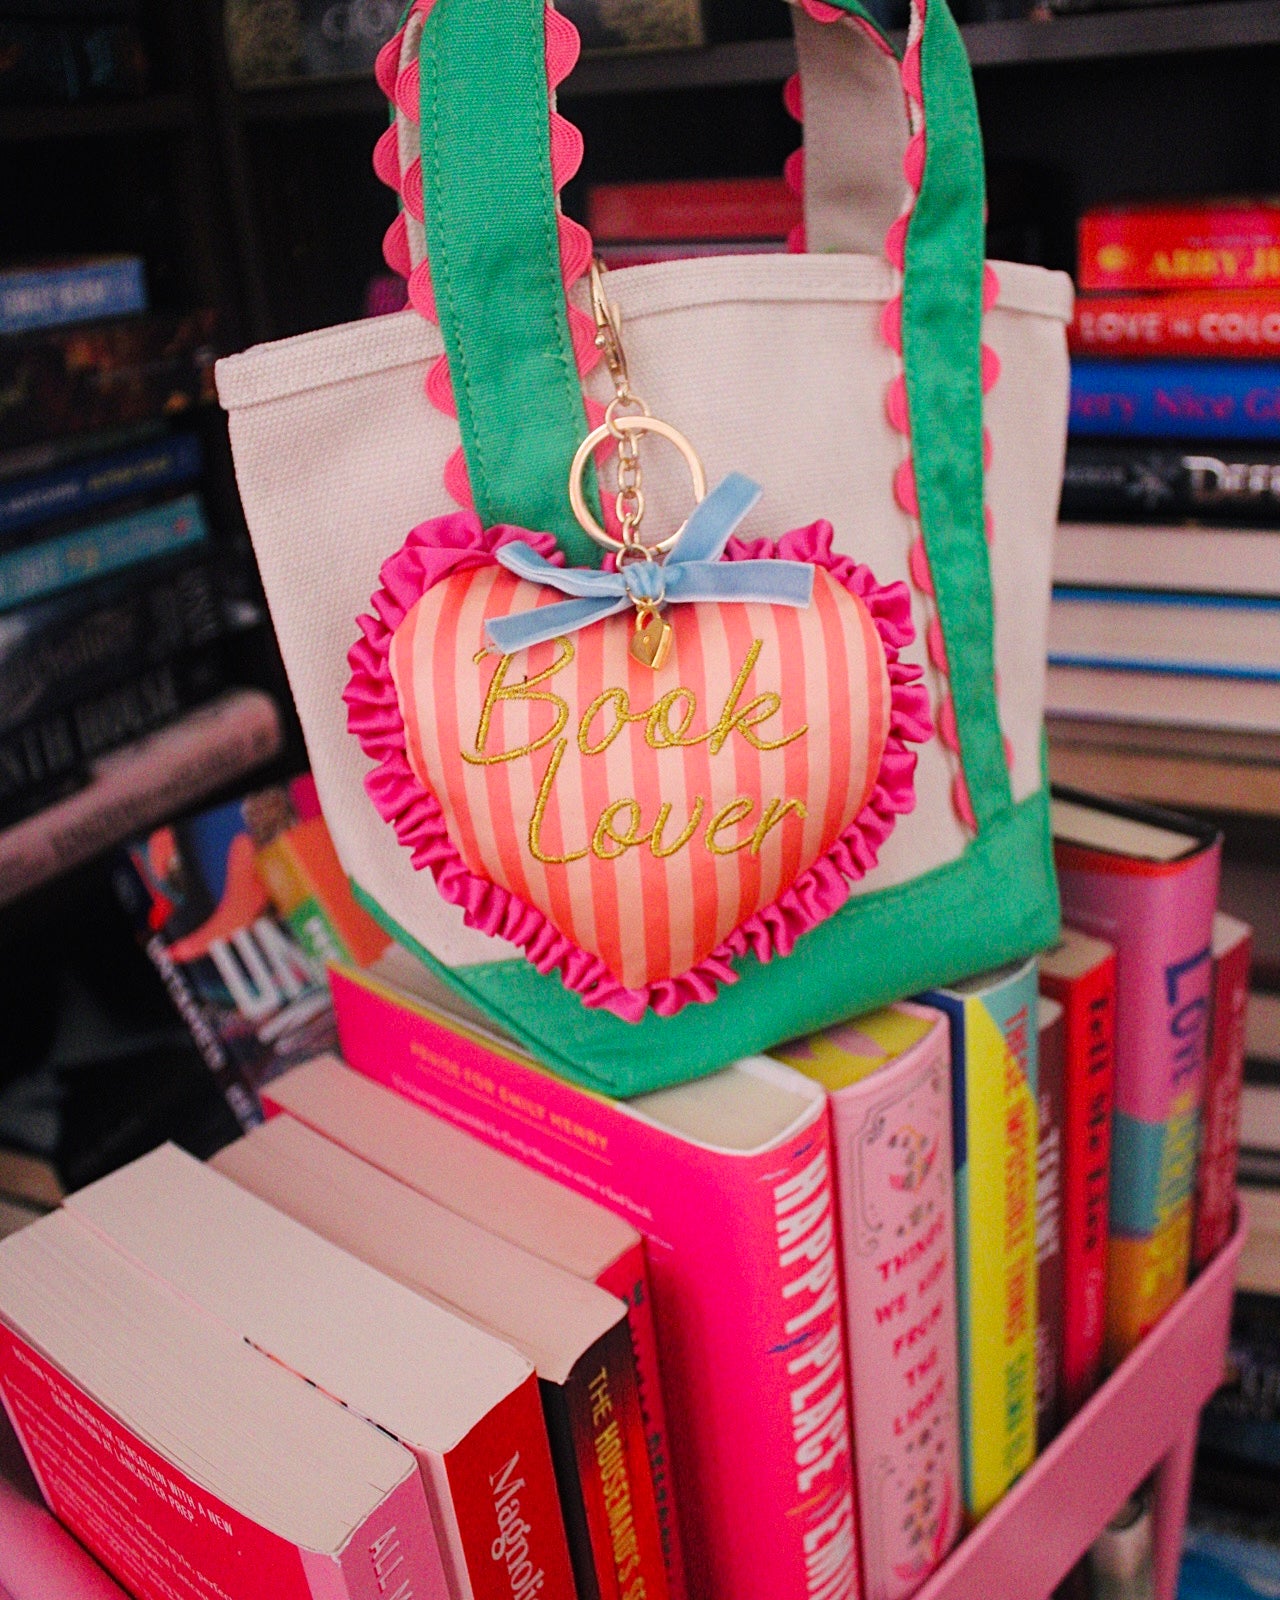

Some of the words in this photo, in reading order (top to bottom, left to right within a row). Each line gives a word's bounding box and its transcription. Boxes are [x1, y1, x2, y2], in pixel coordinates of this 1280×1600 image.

[1078, 311, 1163, 344] LOVE
[460, 637, 809, 765] Book
[528, 738, 809, 864] Lover
[773, 1147, 840, 1335] HAPPY
[588, 1366, 613, 1427] THE
[787, 1324, 848, 1492] PLACE
[166, 1478, 196, 1510] WITH
[198, 1501, 207, 1518] A
[207, 1508, 234, 1537] NEW
[370, 1525, 405, 1591] ALL
